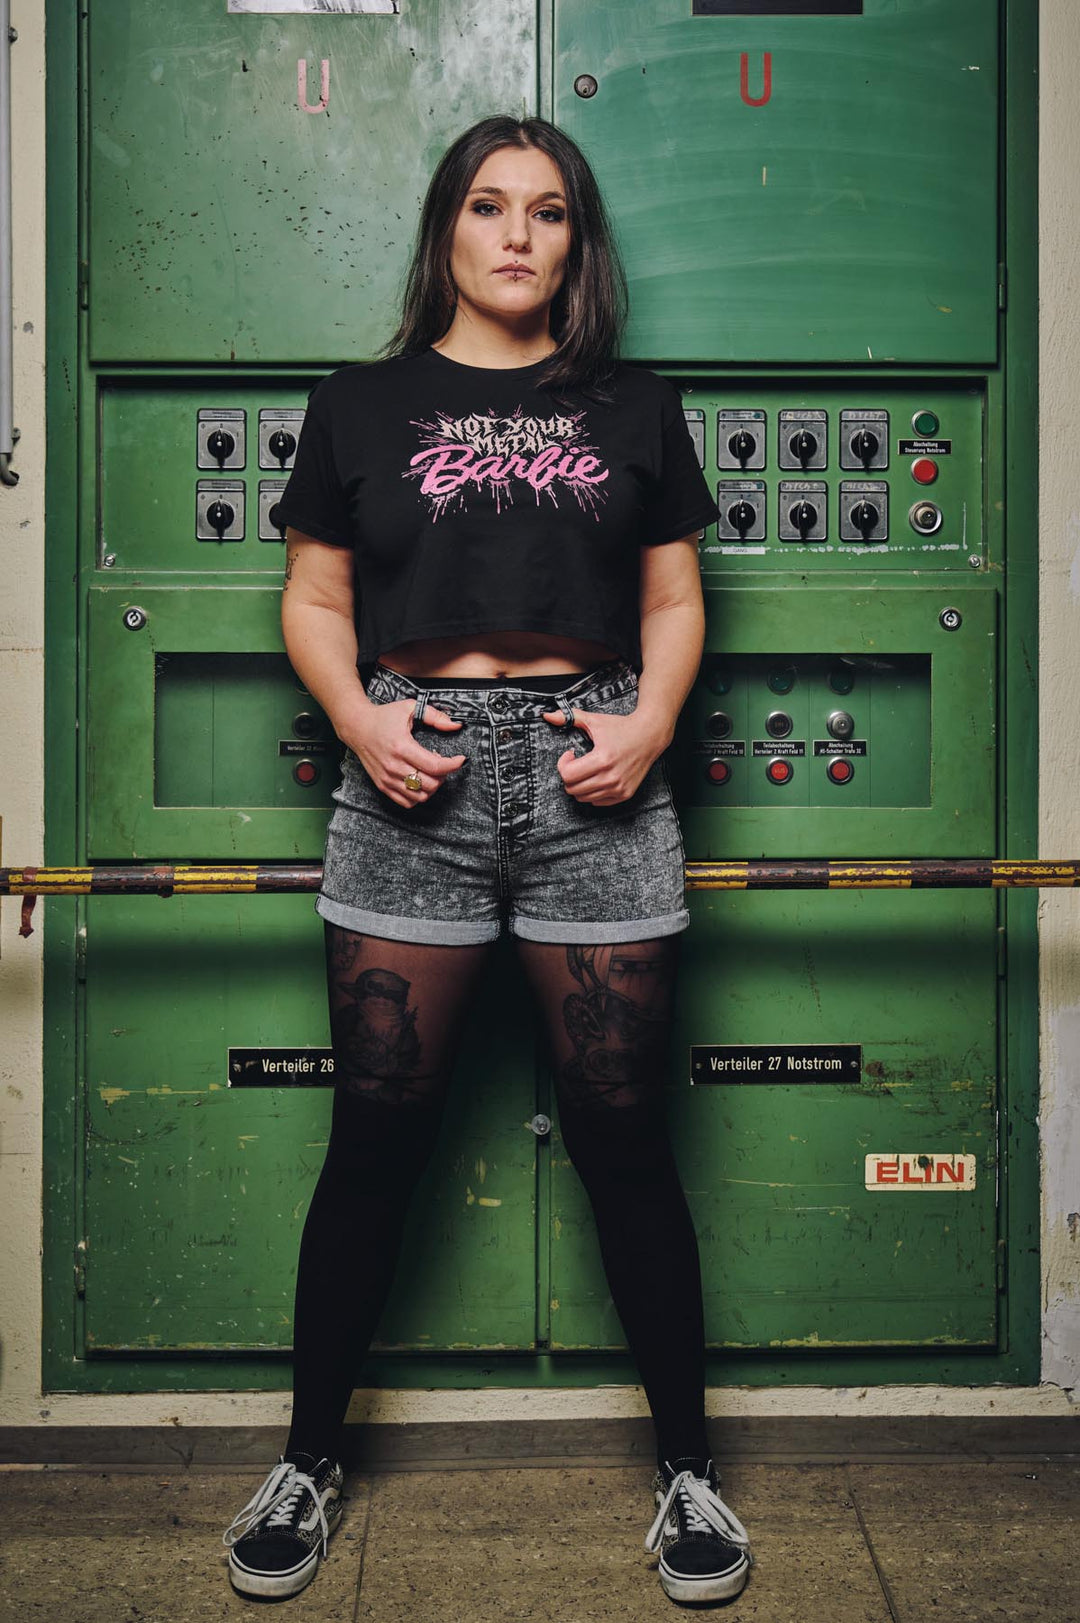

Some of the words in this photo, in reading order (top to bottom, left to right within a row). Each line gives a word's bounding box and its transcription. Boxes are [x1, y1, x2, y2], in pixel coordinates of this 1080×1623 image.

[298, 59, 329, 114] U
[740, 52, 772, 107] U
[500, 412, 582, 439] YOUR
[464, 431, 562, 458] METAL
[409, 444, 609, 495] Barbie
[262, 1058, 316, 1073] Verteiler
[320, 1058, 335, 1073] 26
[710, 1056, 763, 1071] Verteiler
[768, 1056, 782, 1070] 27
[787, 1056, 842, 1070] Notstrom
[876, 1162, 965, 1183] ELIN
